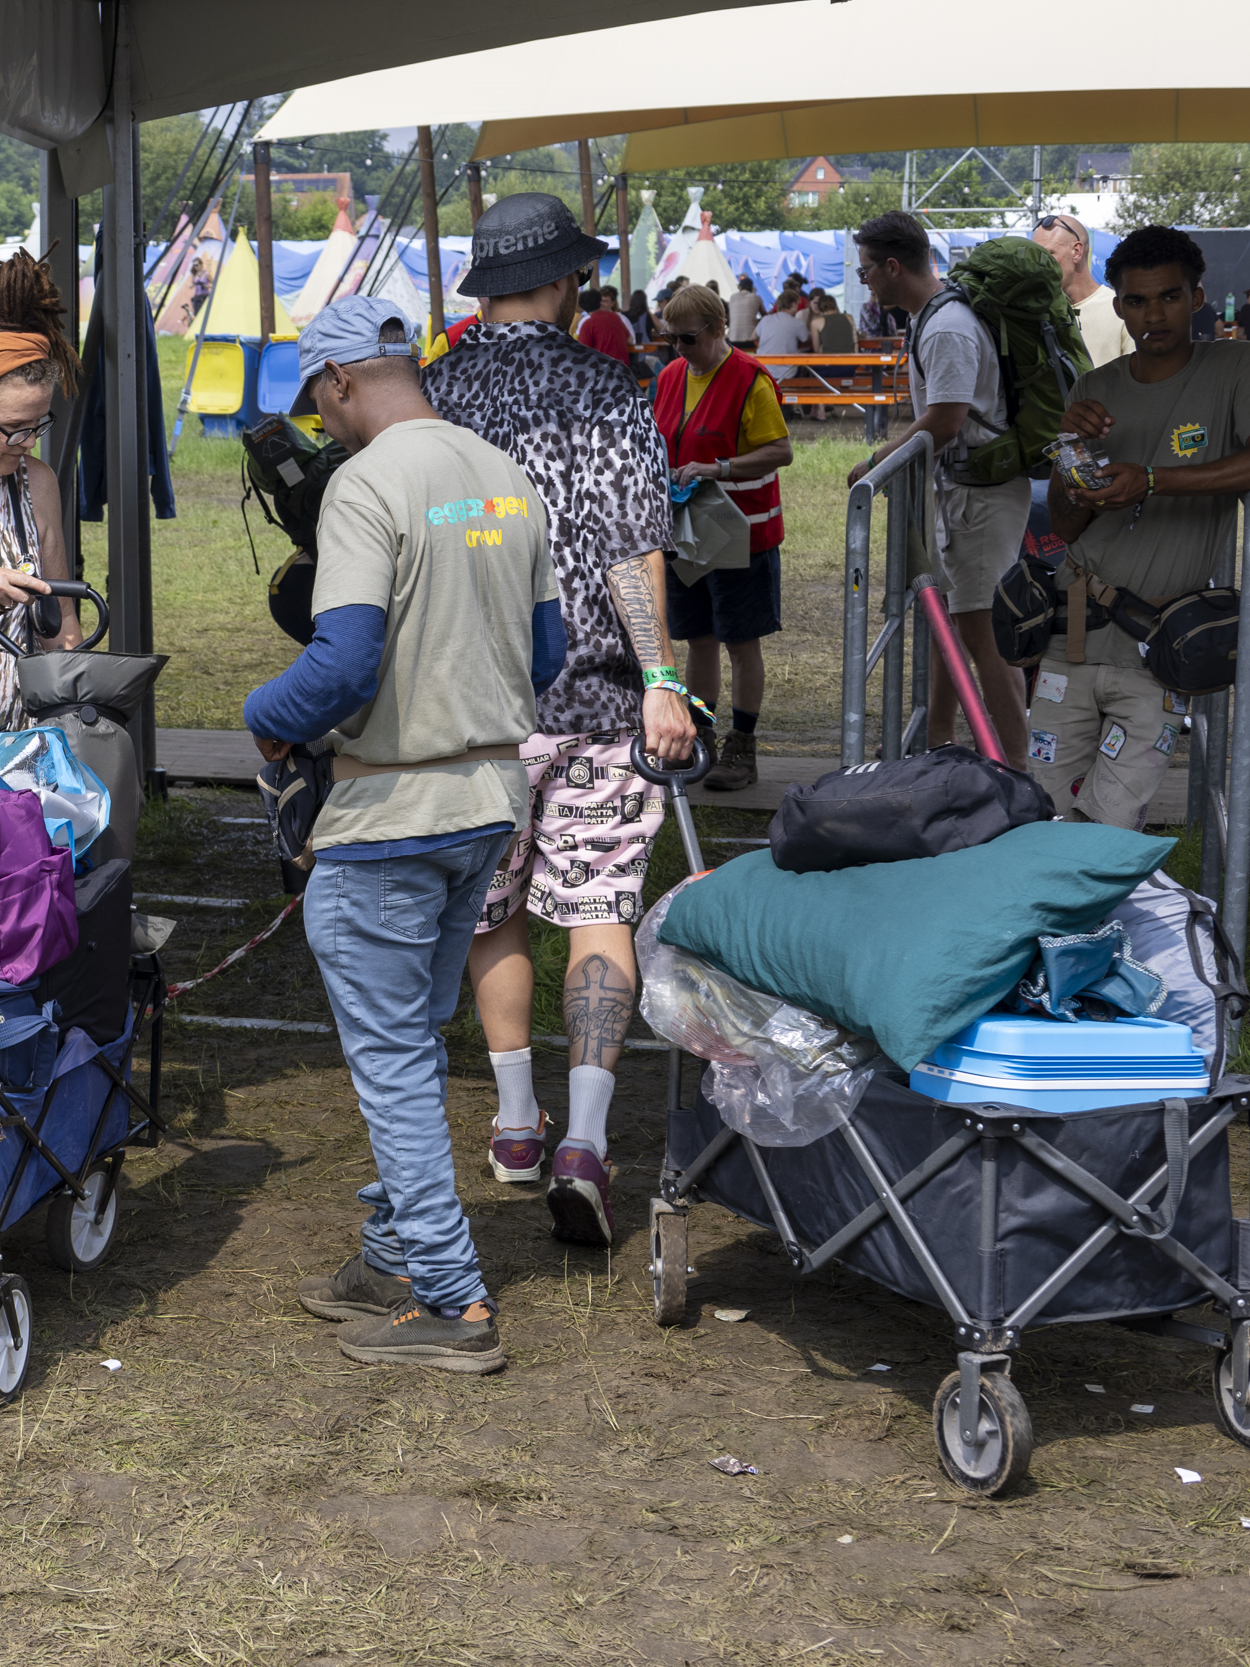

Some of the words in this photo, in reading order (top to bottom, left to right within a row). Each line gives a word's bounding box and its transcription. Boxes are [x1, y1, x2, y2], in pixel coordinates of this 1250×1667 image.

[425, 498, 484, 527] eggae
[1039, 533, 1059, 545] RE
[1042, 539, 1065, 552] WOO
[521, 754, 550, 765] AMILIAR
[545, 803, 570, 817] PATTA
[585, 801, 614, 809] PATTA
[646, 800, 661, 811] PAT
[490, 871, 513, 884] OVE
[578, 896, 608, 904] PATTA
[579, 904, 609, 912] PATTA
[580, 911, 610, 920] PATTA
